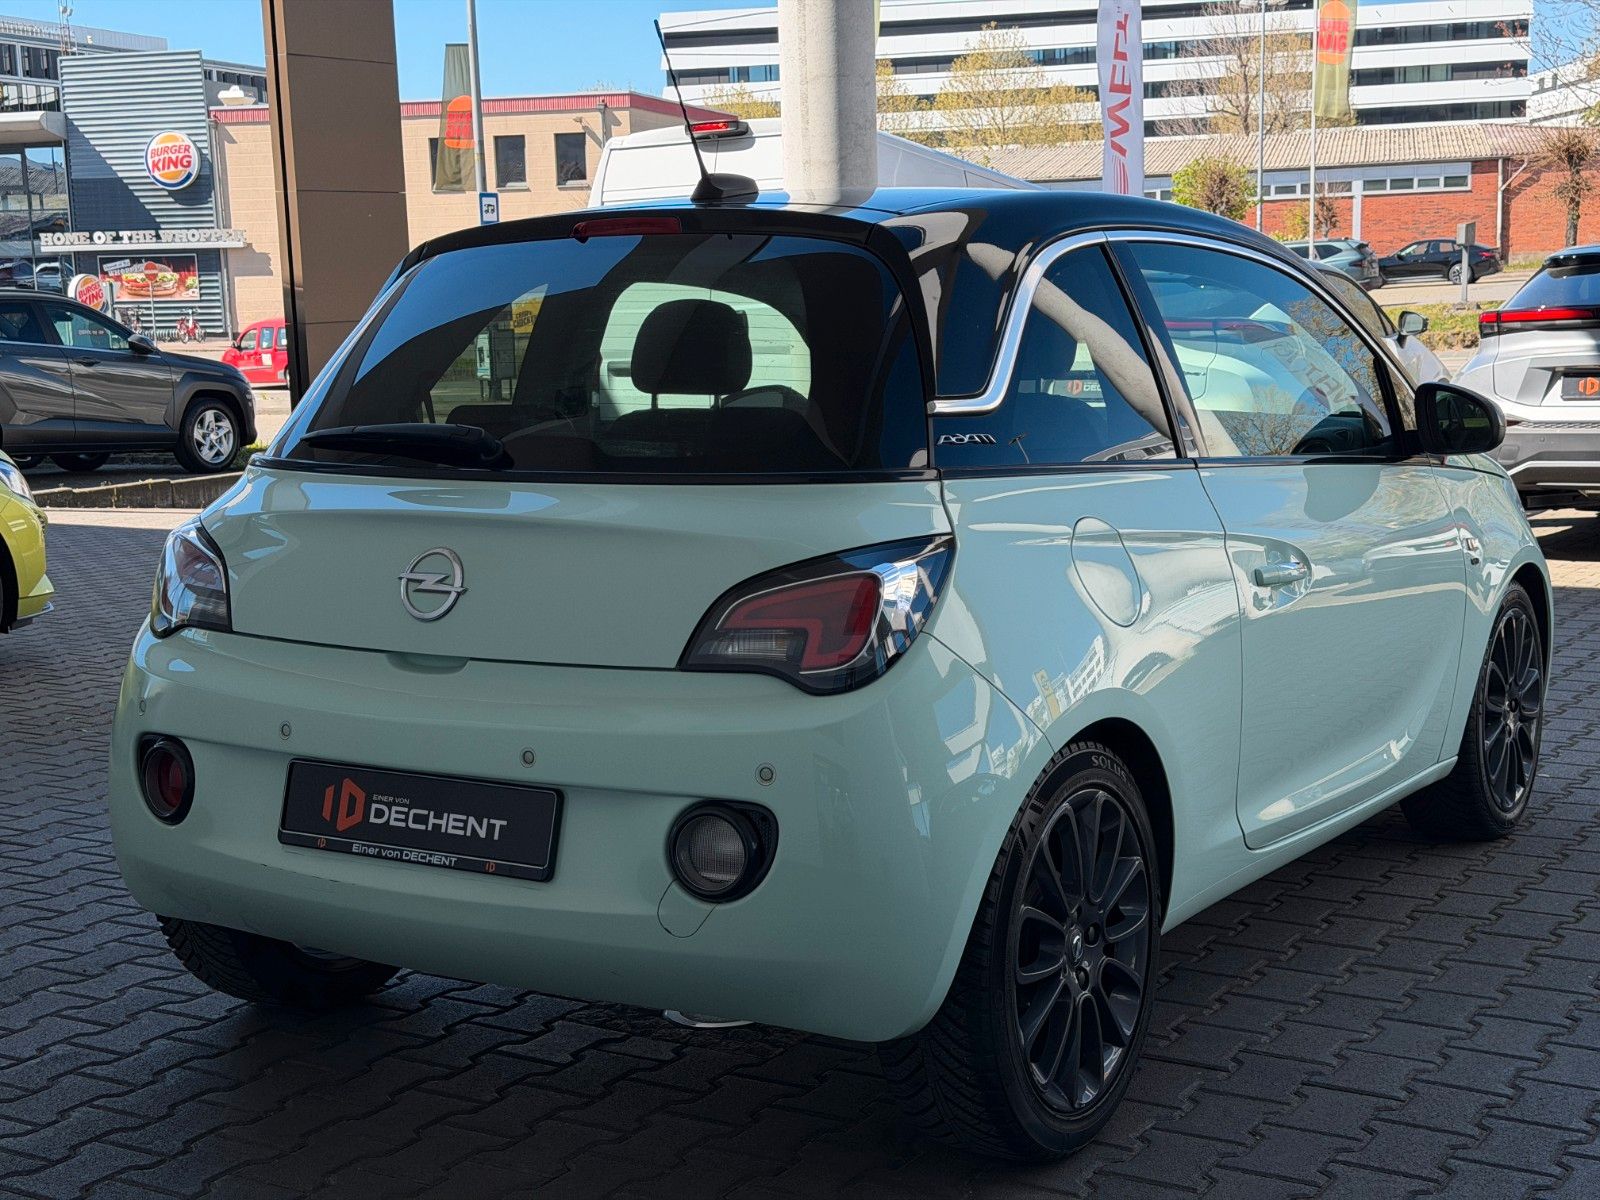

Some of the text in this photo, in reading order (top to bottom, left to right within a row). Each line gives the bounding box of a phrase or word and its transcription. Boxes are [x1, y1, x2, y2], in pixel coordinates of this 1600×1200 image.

[150, 144, 191, 159] BURGER
[151, 155, 193, 175] KING
[38, 228, 247, 245] HOME OF THE WHOPPER
[1091, 755, 1128, 782] SOLUS
[372, 794, 410, 805] EINER VON
[369, 803, 507, 840] DECHENT
[352, 843, 380, 856] Einer
[381, 849, 401, 859] von
[402, 850, 457, 867] DECHENT
